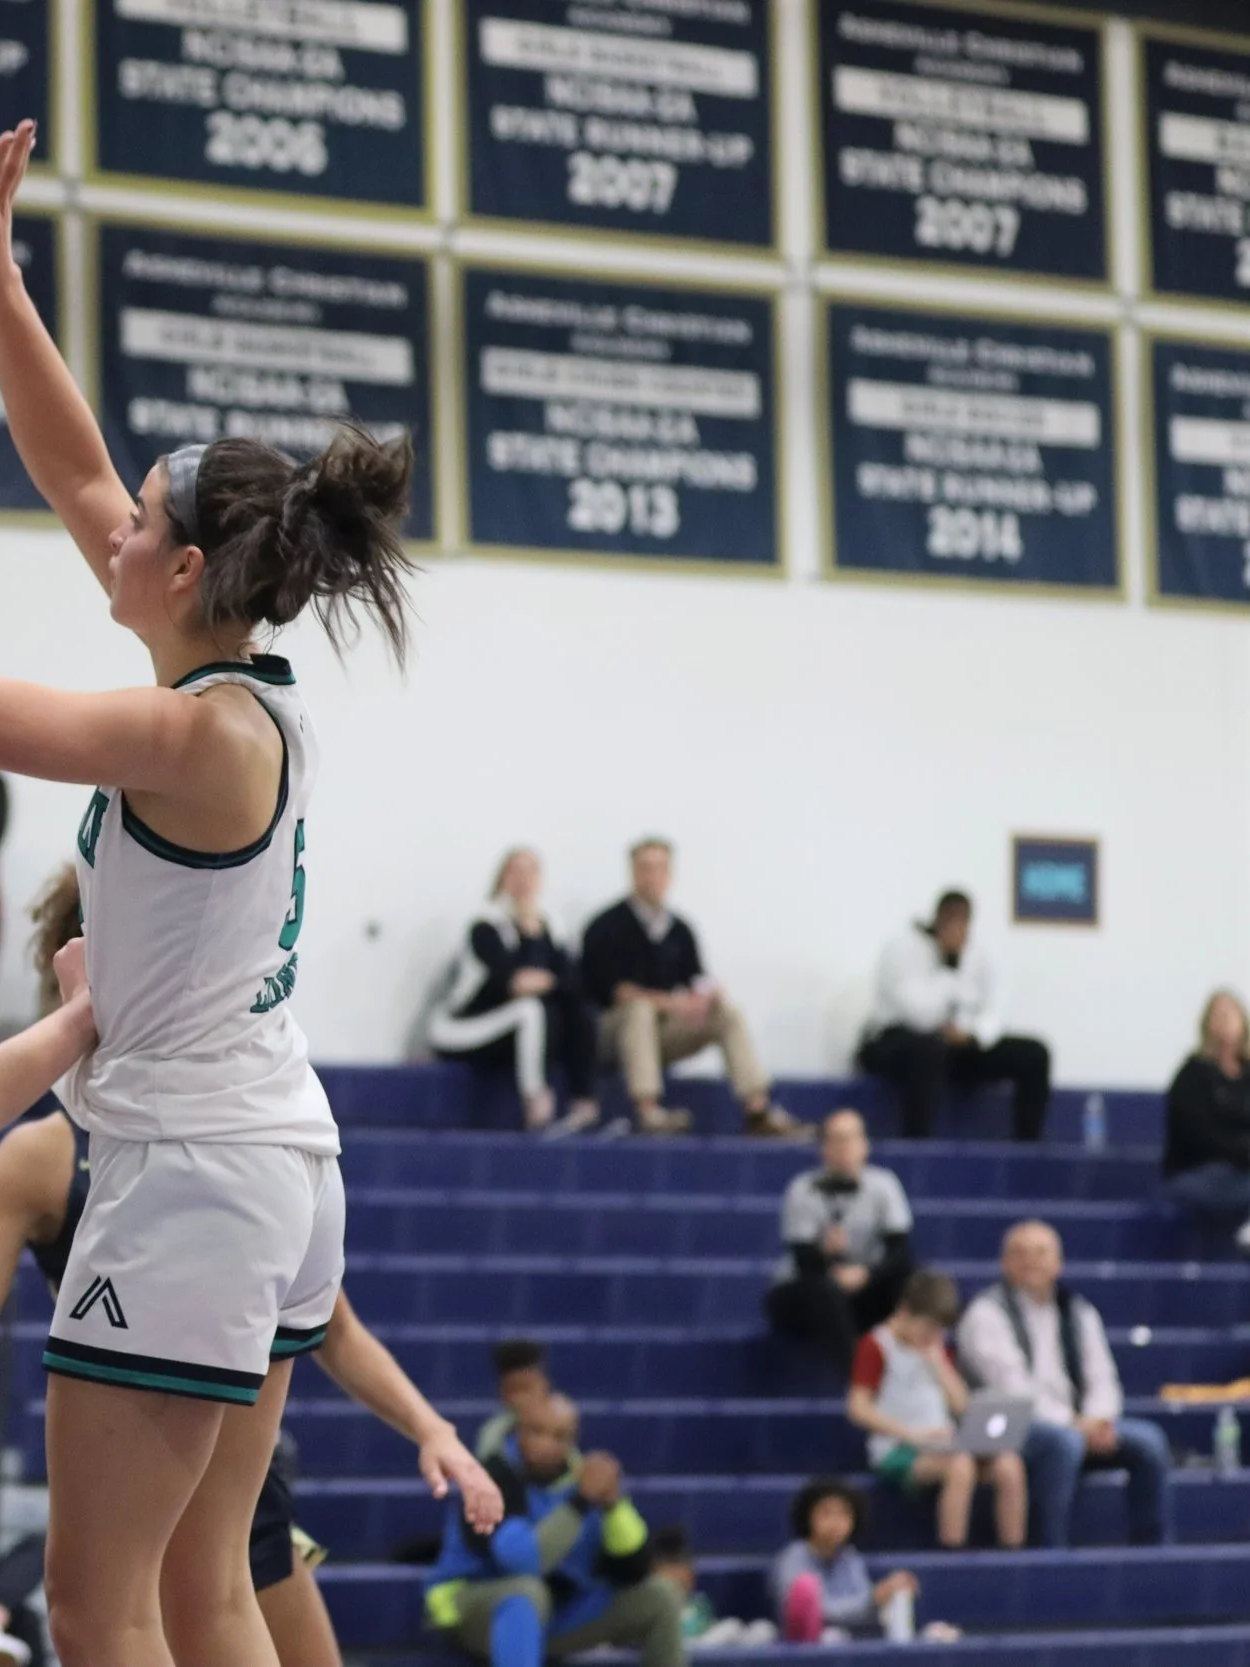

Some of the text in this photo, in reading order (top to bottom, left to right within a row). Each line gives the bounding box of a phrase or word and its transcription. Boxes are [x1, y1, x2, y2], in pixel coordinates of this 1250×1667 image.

[118, 57, 218, 109] STATE
[566, 152, 678, 215] 2007
[839, 147, 924, 194] STATE
[914, 196, 1019, 258] 2007
[486, 429, 581, 476] STATE
[567, 477, 680, 540] 2013
[856, 461, 937, 503] STATE
[927, 503, 1022, 565] 2014
